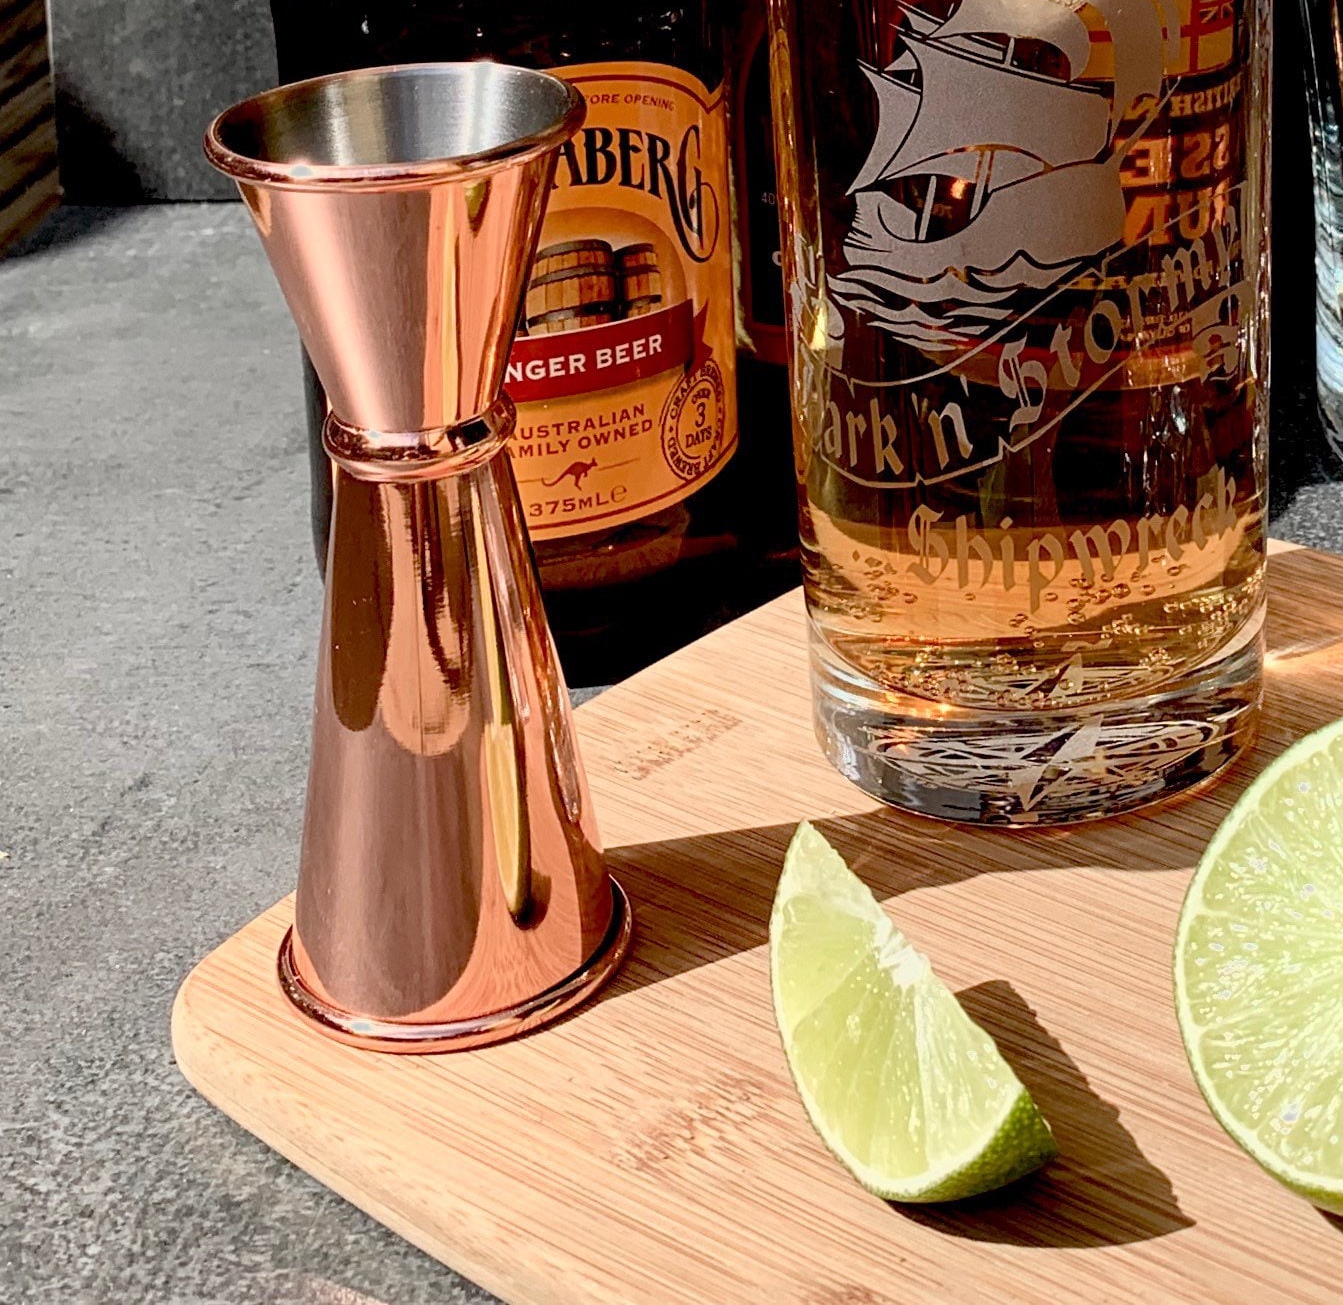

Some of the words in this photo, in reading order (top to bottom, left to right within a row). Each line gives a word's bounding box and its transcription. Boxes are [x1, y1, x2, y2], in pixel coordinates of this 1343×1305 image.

[586, 93, 620, 105] ORE
[623, 93, 676, 112] OPENING
[551, 125, 719, 263] ABERG
[504, 354, 586, 383] NGER
[595, 334, 663, 369] BEER
[694, 401, 706, 428] 3
[511, 439, 570, 459] MILY
[578, 419, 653, 450] OWNED
[685, 426, 712, 448] DAYS
[906, 463, 1238, 614] Shipwreck
